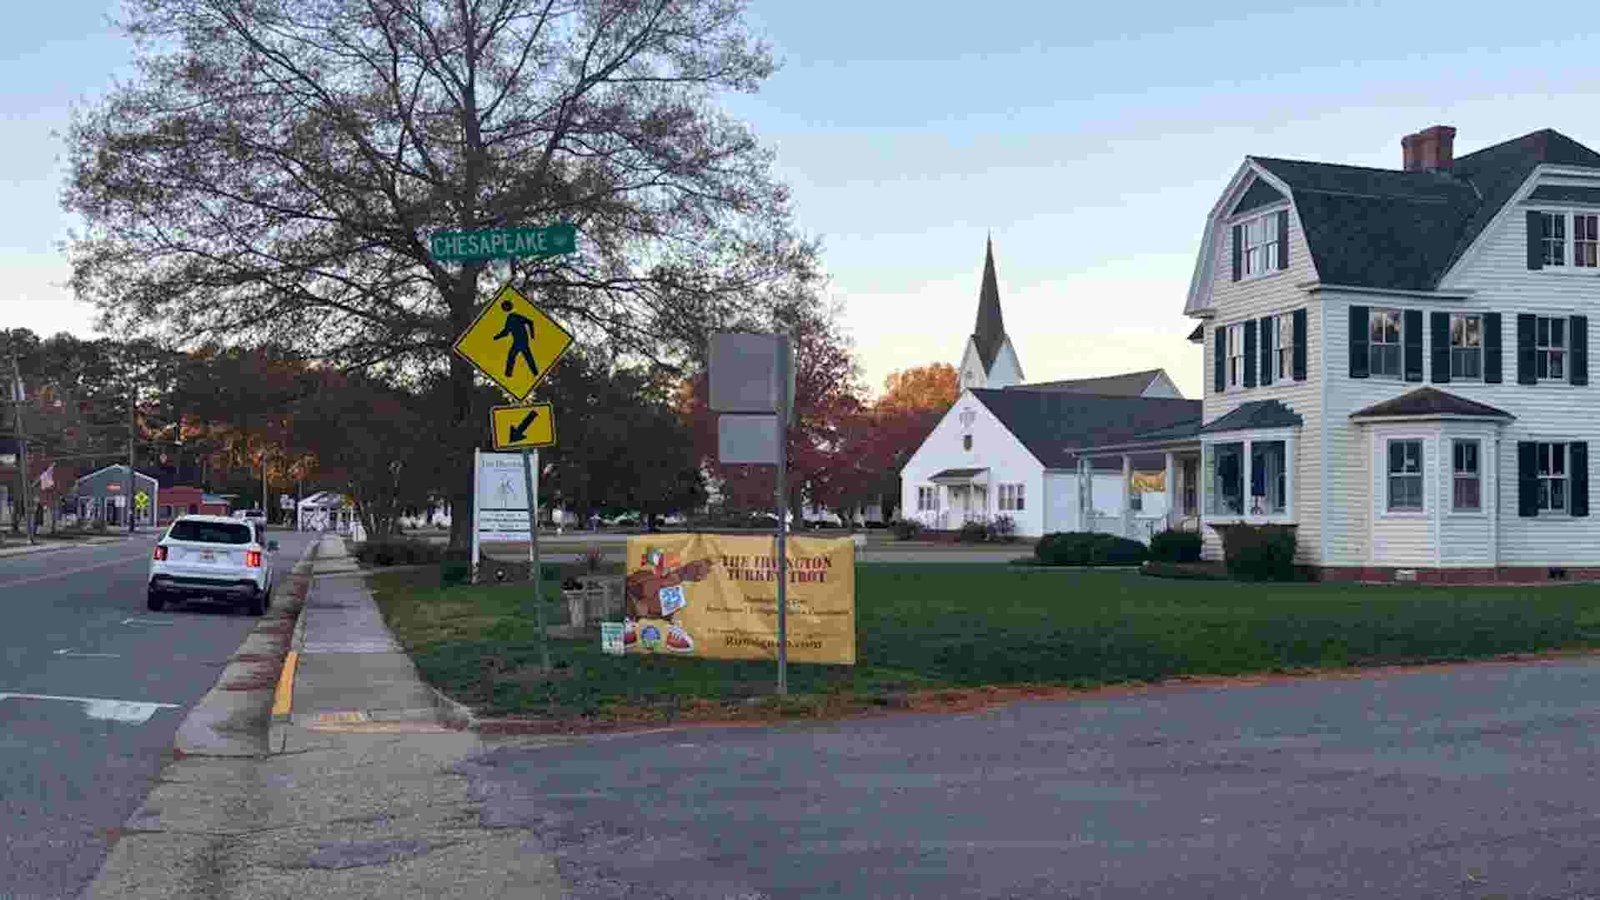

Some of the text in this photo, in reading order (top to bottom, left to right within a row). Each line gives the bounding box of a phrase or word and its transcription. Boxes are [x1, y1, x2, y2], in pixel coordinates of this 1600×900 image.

[433, 230, 548, 256] CHESAPEAKE
[722, 554, 833, 570] THE IRVNGTON
[789, 570, 828, 584] TROT
